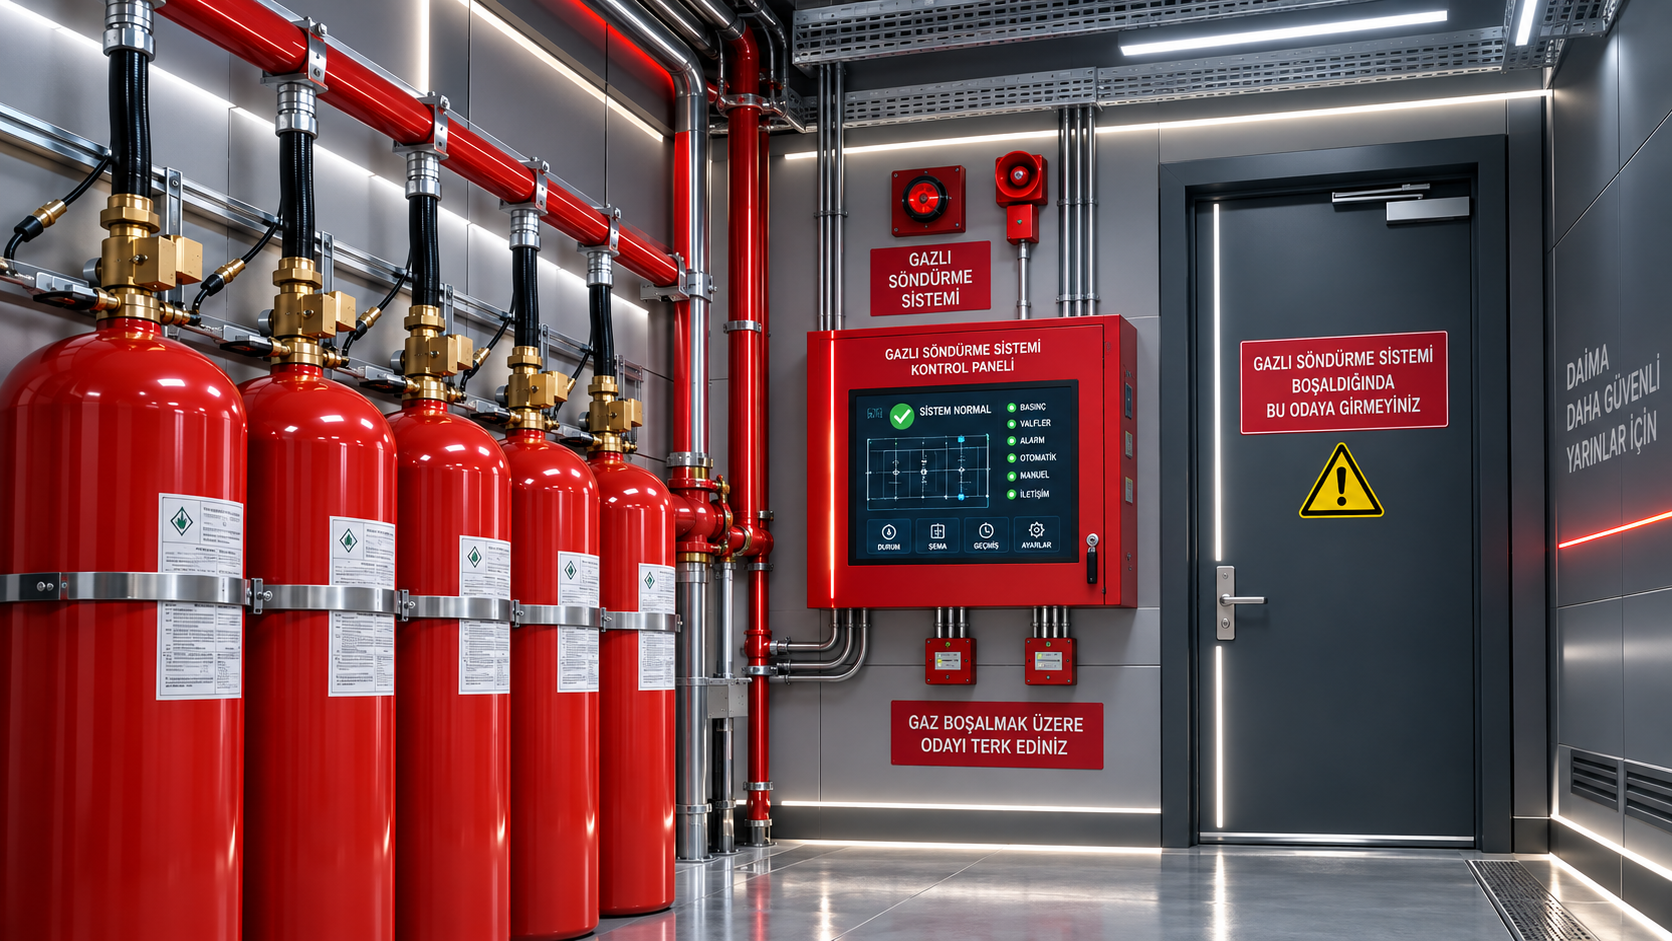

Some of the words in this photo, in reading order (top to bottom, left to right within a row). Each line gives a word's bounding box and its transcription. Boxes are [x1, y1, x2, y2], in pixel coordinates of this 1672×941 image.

[909, 250, 951, 267] GAZLI
[888, 268, 973, 289] SÖNDÜRME
[901, 287, 960, 309] SİSTEMİ
[885, 347, 919, 360] GAZLI
[922, 342, 990, 359] SÖNDÜRME
[994, 338, 1041, 355] SİSTEMİ
[1253, 355, 1292, 371] GAZLI
[1296, 349, 1375, 370] SÖNDÜRME
[1379, 344, 1434, 366] SİSTEMİ
[911, 362, 969, 376] KONTROL
[972, 357, 1014, 373] PANELİ
[1566, 343, 1609, 391] DAİMA
[1292, 372, 1395, 396] BOŞALDIĞINDA
[1566, 390, 1601, 432] DAHA
[1604, 352, 1660, 414] GÜVENLİ
[919, 404, 951, 417] SİSTEM
[953, 404, 992, 415] NORMAL
[1020, 402, 1047, 412] BASINÇ
[1266, 402, 1285, 418] BU
[1290, 401, 1336, 417] ODAYA
[1339, 394, 1421, 416] GİRMEYİNİZ
[1020, 418, 1051, 428] VALFLER
[1020, 436, 1045, 444] ALARM
[1566, 424, 1627, 474] YARINLAR
[1630, 406, 1657, 455] İÇİN
[1020, 452, 1057, 462] OTOMATİK
[1020, 470, 1050, 480] MANUEL
[908, 714, 939, 730] GAZ
[943, 715, 1028, 735] BOŞALMAK
[1033, 713, 1084, 732] ÜZERE
[920, 737, 966, 753] ODAYI
[971, 738, 1011, 754] TERK
[1016, 736, 1068, 756] EDİNİZ
